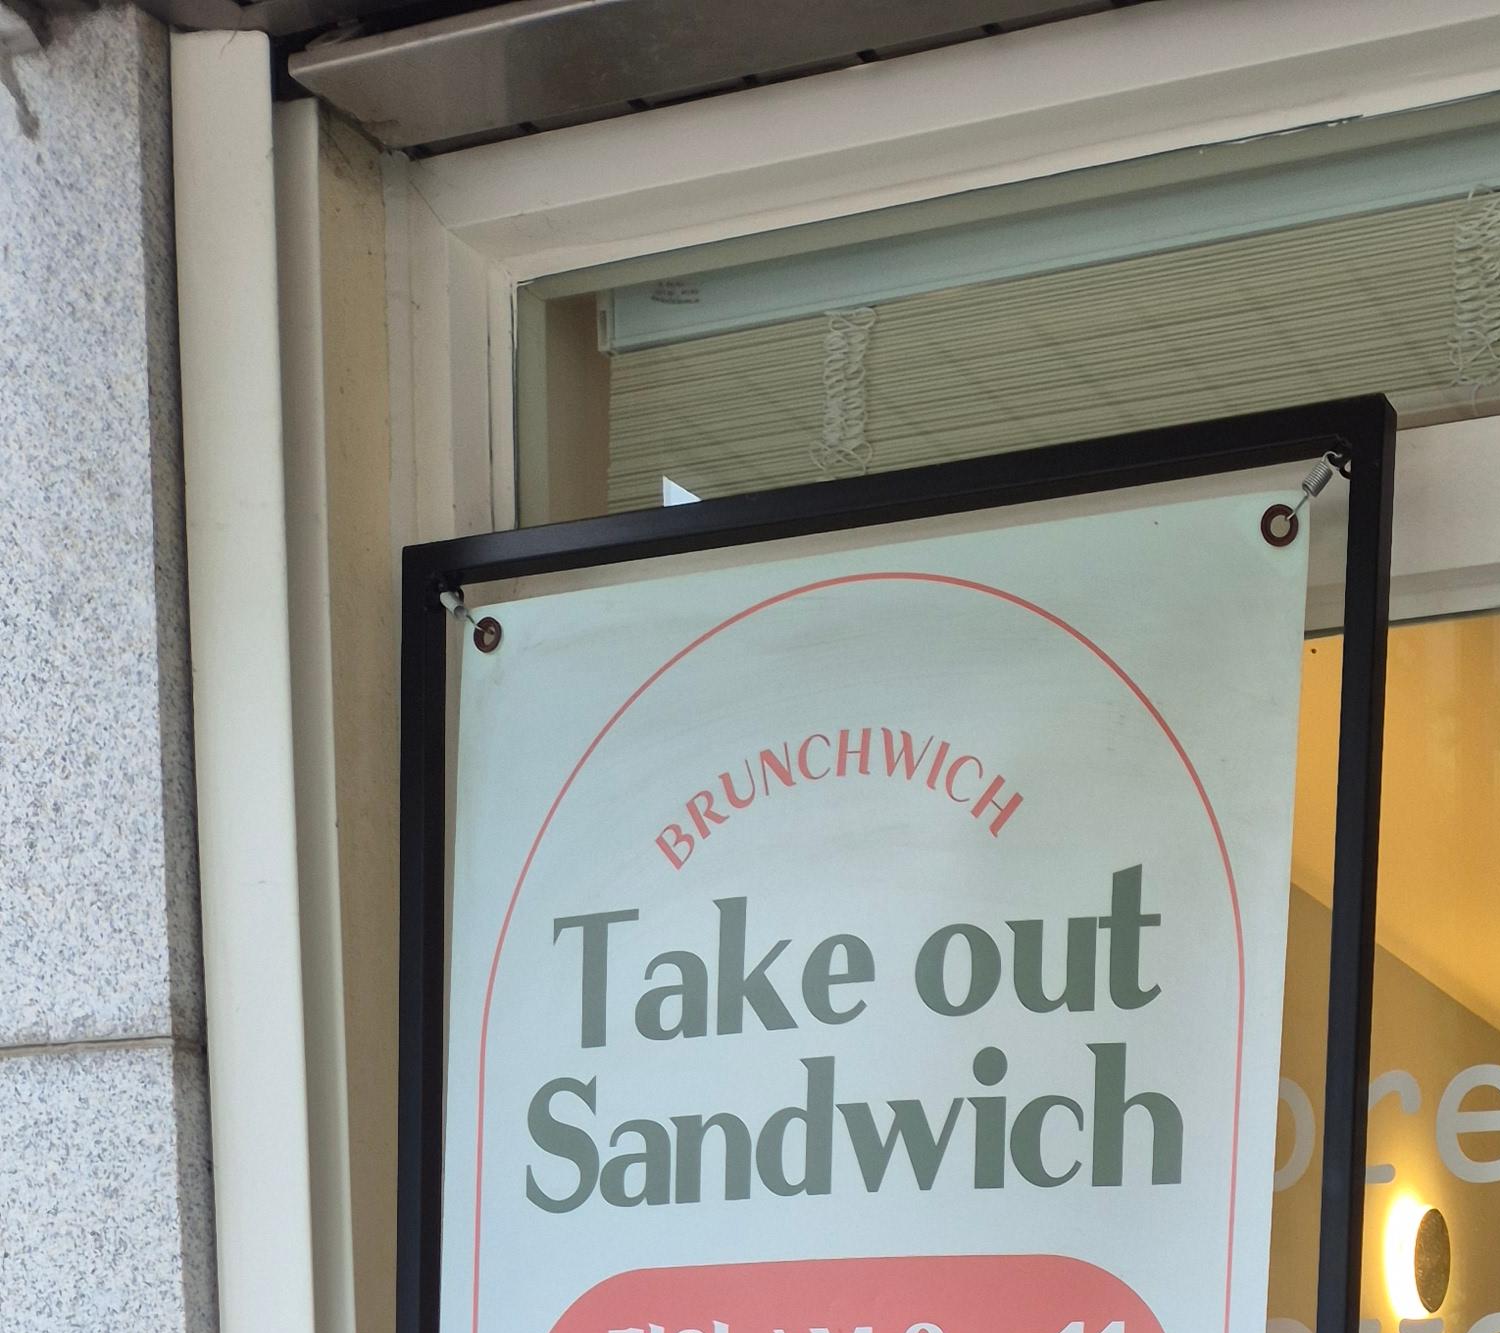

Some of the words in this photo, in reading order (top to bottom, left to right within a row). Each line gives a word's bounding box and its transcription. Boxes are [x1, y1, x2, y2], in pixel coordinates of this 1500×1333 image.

[654, 726, 1025, 871] BRUNCHWICH
[552, 895, 876, 1050] Take
[914, 863, 1162, 1018] out
[525, 1041, 1184, 1215] Sandwich
